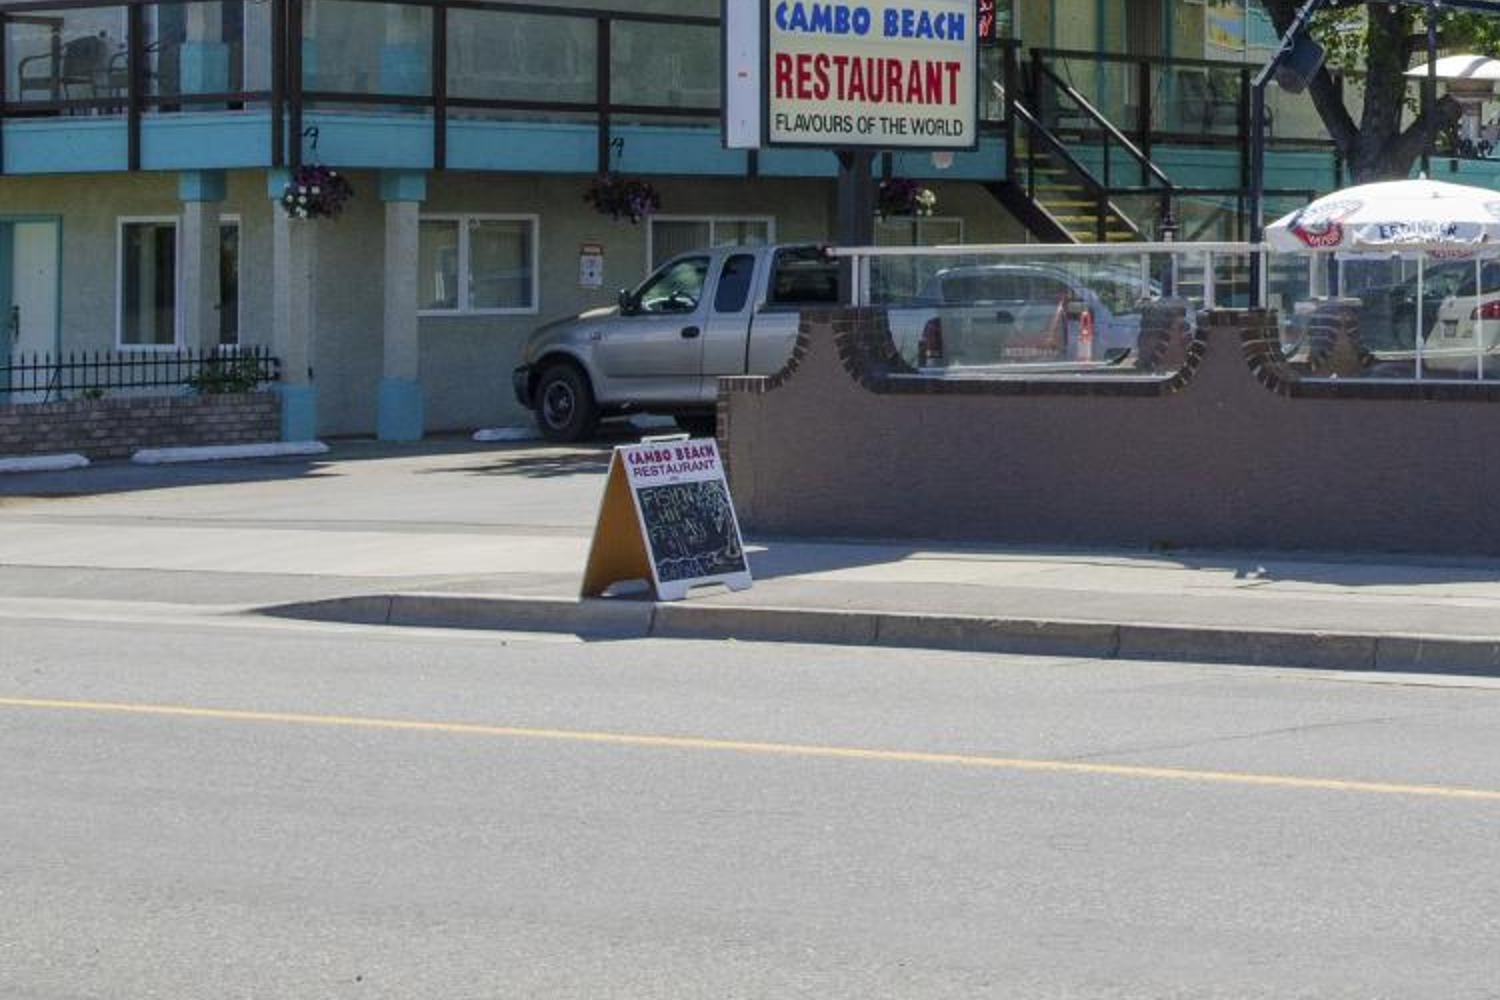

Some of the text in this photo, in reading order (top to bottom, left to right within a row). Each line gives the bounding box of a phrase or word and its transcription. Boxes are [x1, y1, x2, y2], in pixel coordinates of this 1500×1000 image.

[775, 0, 966, 41] CAMBO BEACH
[775, 52, 961, 105] RESTAURANT
[775, 113, 963, 137] FLAVOURS OF THE WORLD
[628, 445, 714, 465] CAMBO BEACH
[633, 460, 715, 477] RESTAURANT
